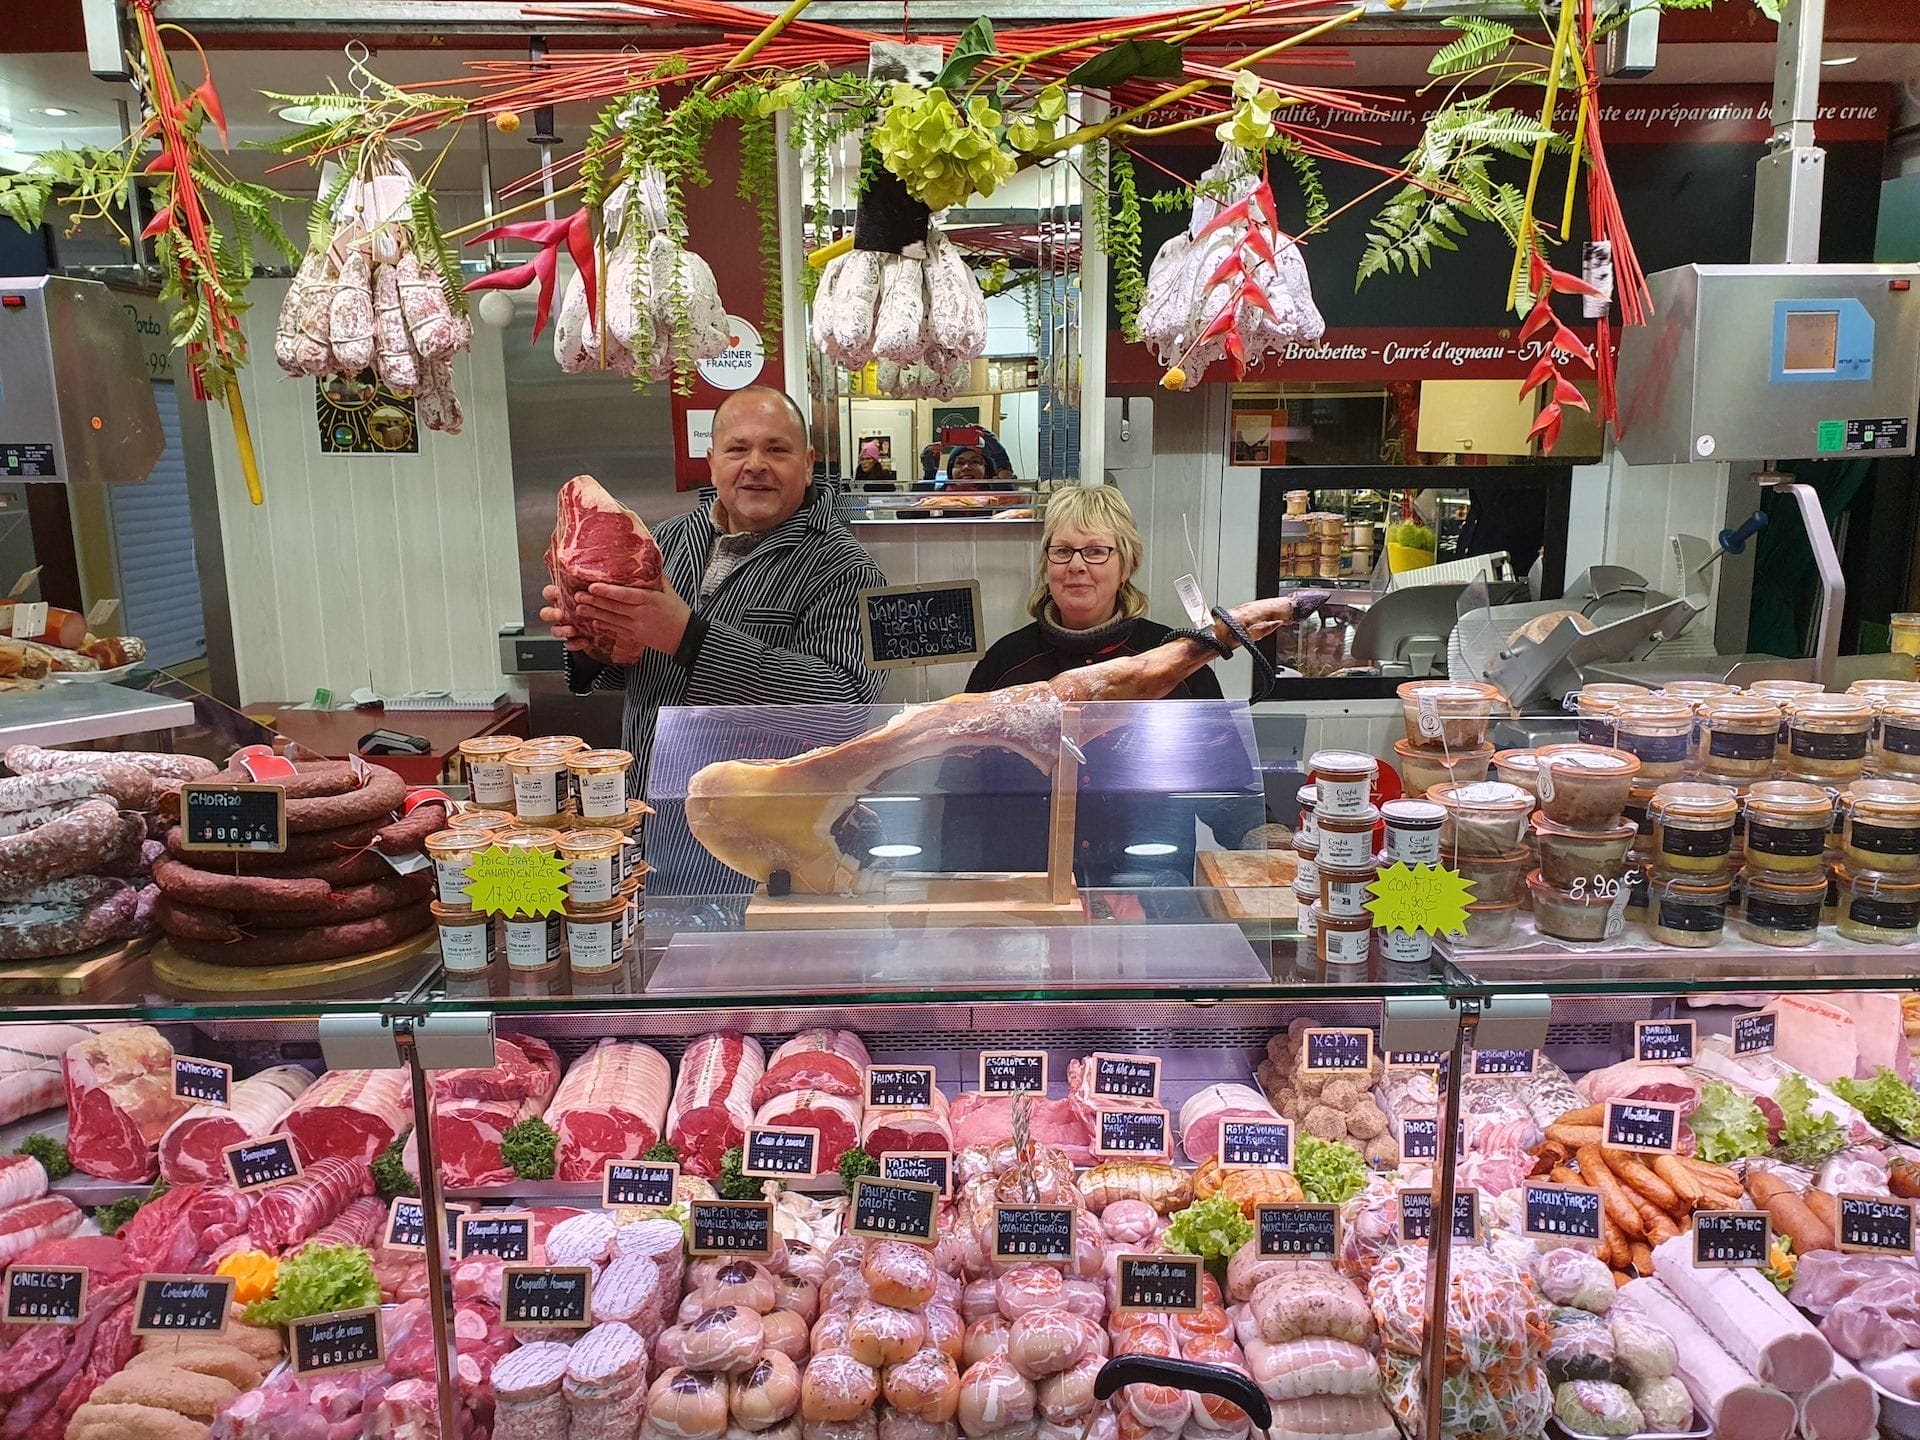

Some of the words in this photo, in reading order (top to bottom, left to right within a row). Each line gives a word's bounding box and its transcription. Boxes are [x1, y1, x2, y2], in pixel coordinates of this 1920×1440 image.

[1269, 104, 1321, 131] ualité,
[1624, 109, 1644, 123] en
[1645, 102, 1754, 128] préparation
[1840, 107, 1878, 121] crue
[1284, 341, 1368, 361] Brochettes
[1382, 341, 1430, 365] Carré
[1432, 341, 1504, 366] d'agneau
[706, 360, 752, 370] FRANÇAIS
[868, 597, 935, 622] JAMBON
[507, 856, 535, 866] GRAS
[1313, 1034, 1358, 1049] KEFTA
[1735, 1219, 1763, 1232] PORC
